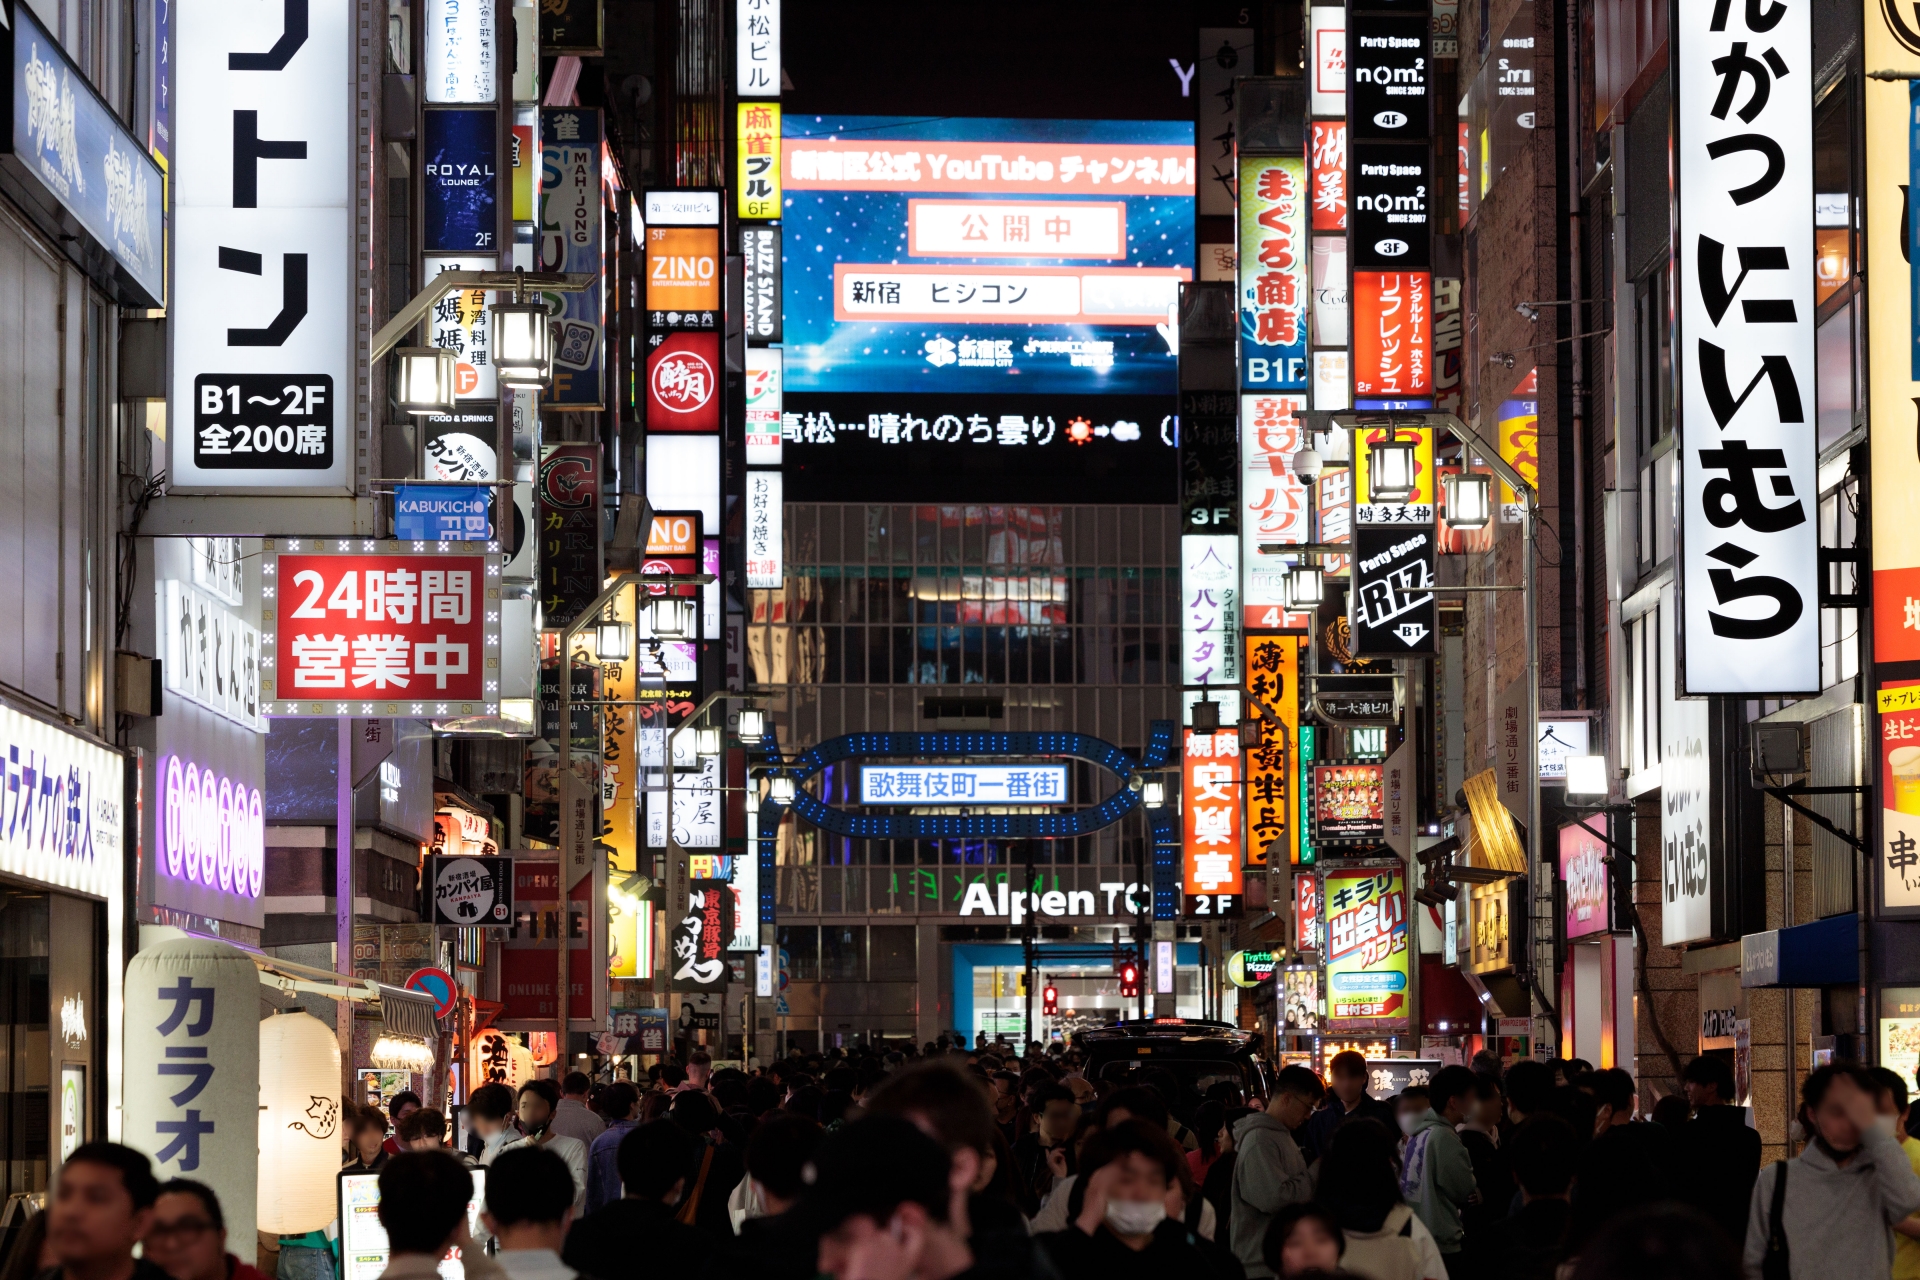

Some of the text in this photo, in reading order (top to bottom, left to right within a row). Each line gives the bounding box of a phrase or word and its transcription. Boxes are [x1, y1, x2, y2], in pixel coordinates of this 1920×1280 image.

[1361, 36, 1420, 50] Party Space
[1386, 86, 1425, 95] SINCE 2007
[541, 113, 580, 141] 雀
[1382, 113, 1399, 126] 4F
[745, 106, 772, 198] 麻雀ブル
[426, 164, 495, 176] ROYAL
[926, 154, 1054, 182] YouTube
[1362, 164, 1421, 178] Party Space
[574, 152, 588, 243] MAH-JONG
[651, 203, 712, 214] 第二安田ビル
[748, 202, 770, 216] 6F
[960, 213, 1072, 243] 公開中
[1387, 214, 1426, 223] SINCE 2007
[475, 232, 492, 247] 2F
[651, 229, 666, 240] 5F
[1383, 241, 1400, 253] 3F
[743, 231, 755, 265] DARTS
[1255, 169, 1298, 344] まぐろ商店
[652, 256, 715, 279] ZINO
[757, 230, 774, 337] BUZZ STAND
[852, 280, 901, 305] 新宿
[470, 289, 487, 366] 台湾料理
[1379, 274, 1402, 393] リフレッシュ
[1410, 274, 1424, 388] レンタルルーム ホステル
[649, 335, 663, 346] 4F
[1248, 357, 1304, 383] B1F
[1358, 381, 1372, 393] 2F
[429, 414, 494, 423] FOOD & DRINKS
[199, 423, 327, 455] 全200席
[748, 435, 773, 445] ATM
[427, 439, 475, 480] カンパ
[456, 444, 489, 480] 新宿酒場
[400, 500, 485, 513] KABUKICHO
[752, 477, 769, 556] お好み焼き
[1190, 508, 1231, 525] 3F
[1357, 503, 1431, 523] 博多天神
[441, 516, 462, 540] FE
[464, 516, 485, 540] BL
[653, 518, 691, 544] NO
[646, 544, 687, 552] AINMENT BAR
[1358, 533, 1428, 574] Party Space
[544, 511, 565, 613] カリーナ
[291, 569, 472, 625] 24時間
[1262, 606, 1297, 628] 4F
[1189, 588, 1219, 685] バンタイ
[1223, 588, 1235, 680] タイ国料理専門店
[1402, 626, 1421, 637] B1
[292, 633, 469, 690] 営業中
[682, 644, 696, 656] 2F
[1325, 702, 1393, 715] 第一大滝ビル
[1884, 716, 1920, 741] 生ビー
[1186, 732, 1239, 758] 焼肉
[1504, 705, 1520, 794] 劇場通り一番街
[868, 771, 1060, 799] 歌舞伎町一番街
[1390, 768, 1402, 837] 劇場通り一番街
[574, 797, 586, 866] 劇場通り一番街
[650, 810, 664, 846] 一番街
[694, 834, 720, 846] B1F
[1664, 817, 1708, 906] にいむら
[435, 874, 494, 900] カンパイ屋
[448, 870, 477, 882] 新宿酒場
[518, 875, 549, 888] OPEN
[450, 892, 482, 903] KANPAIYA
[1332, 869, 1394, 911] キラリ
[495, 907, 507, 917] B1
[959, 882, 1095, 925] Alpen
[1194, 895, 1233, 915] 2F
[703, 887, 721, 959] 東京豚骨
[1331, 893, 1402, 957] 出会い
[1243, 951, 1274, 962] Tratto
[1361, 930, 1407, 969] カフェ
[509, 983, 550, 996] ONLINE
[641, 1016, 665, 1025] フリー
[1336, 1003, 1385, 1016] 受付3F
[156, 976, 216, 1183] カラオ
